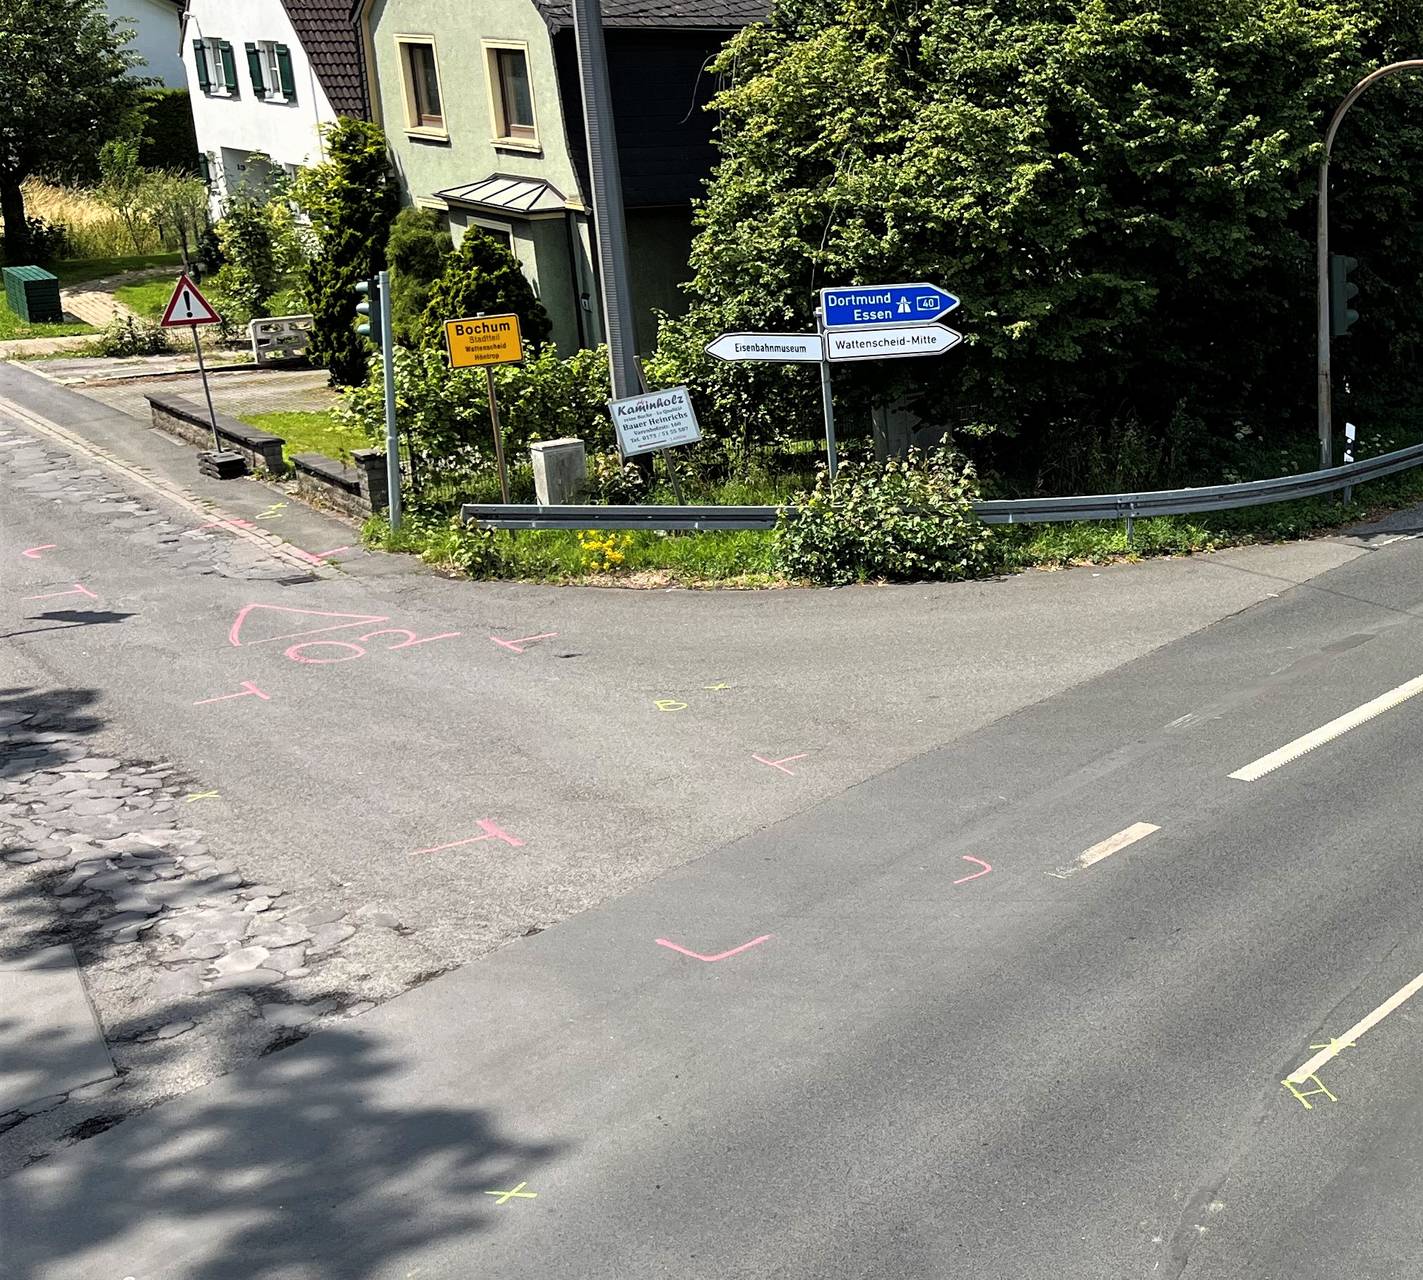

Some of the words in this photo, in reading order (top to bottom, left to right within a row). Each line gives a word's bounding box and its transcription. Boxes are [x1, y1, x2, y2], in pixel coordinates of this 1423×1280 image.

[828, 292, 891, 307] Dortmund
[923, 298, 934, 308] 40
[854, 309, 892, 321] Essen
[455, 322, 511, 336] Bochum
[465, 343, 507, 352] Wattenscheid
[735, 342, 807, 353] Eisenbahnmuseum
[835, 335, 937, 349] Wattenscheid-Mitte
[617, 394, 684, 416] Kaminholz
[622, 420, 647, 431] Bauer
[648, 411, 688, 426] Heinrichs
